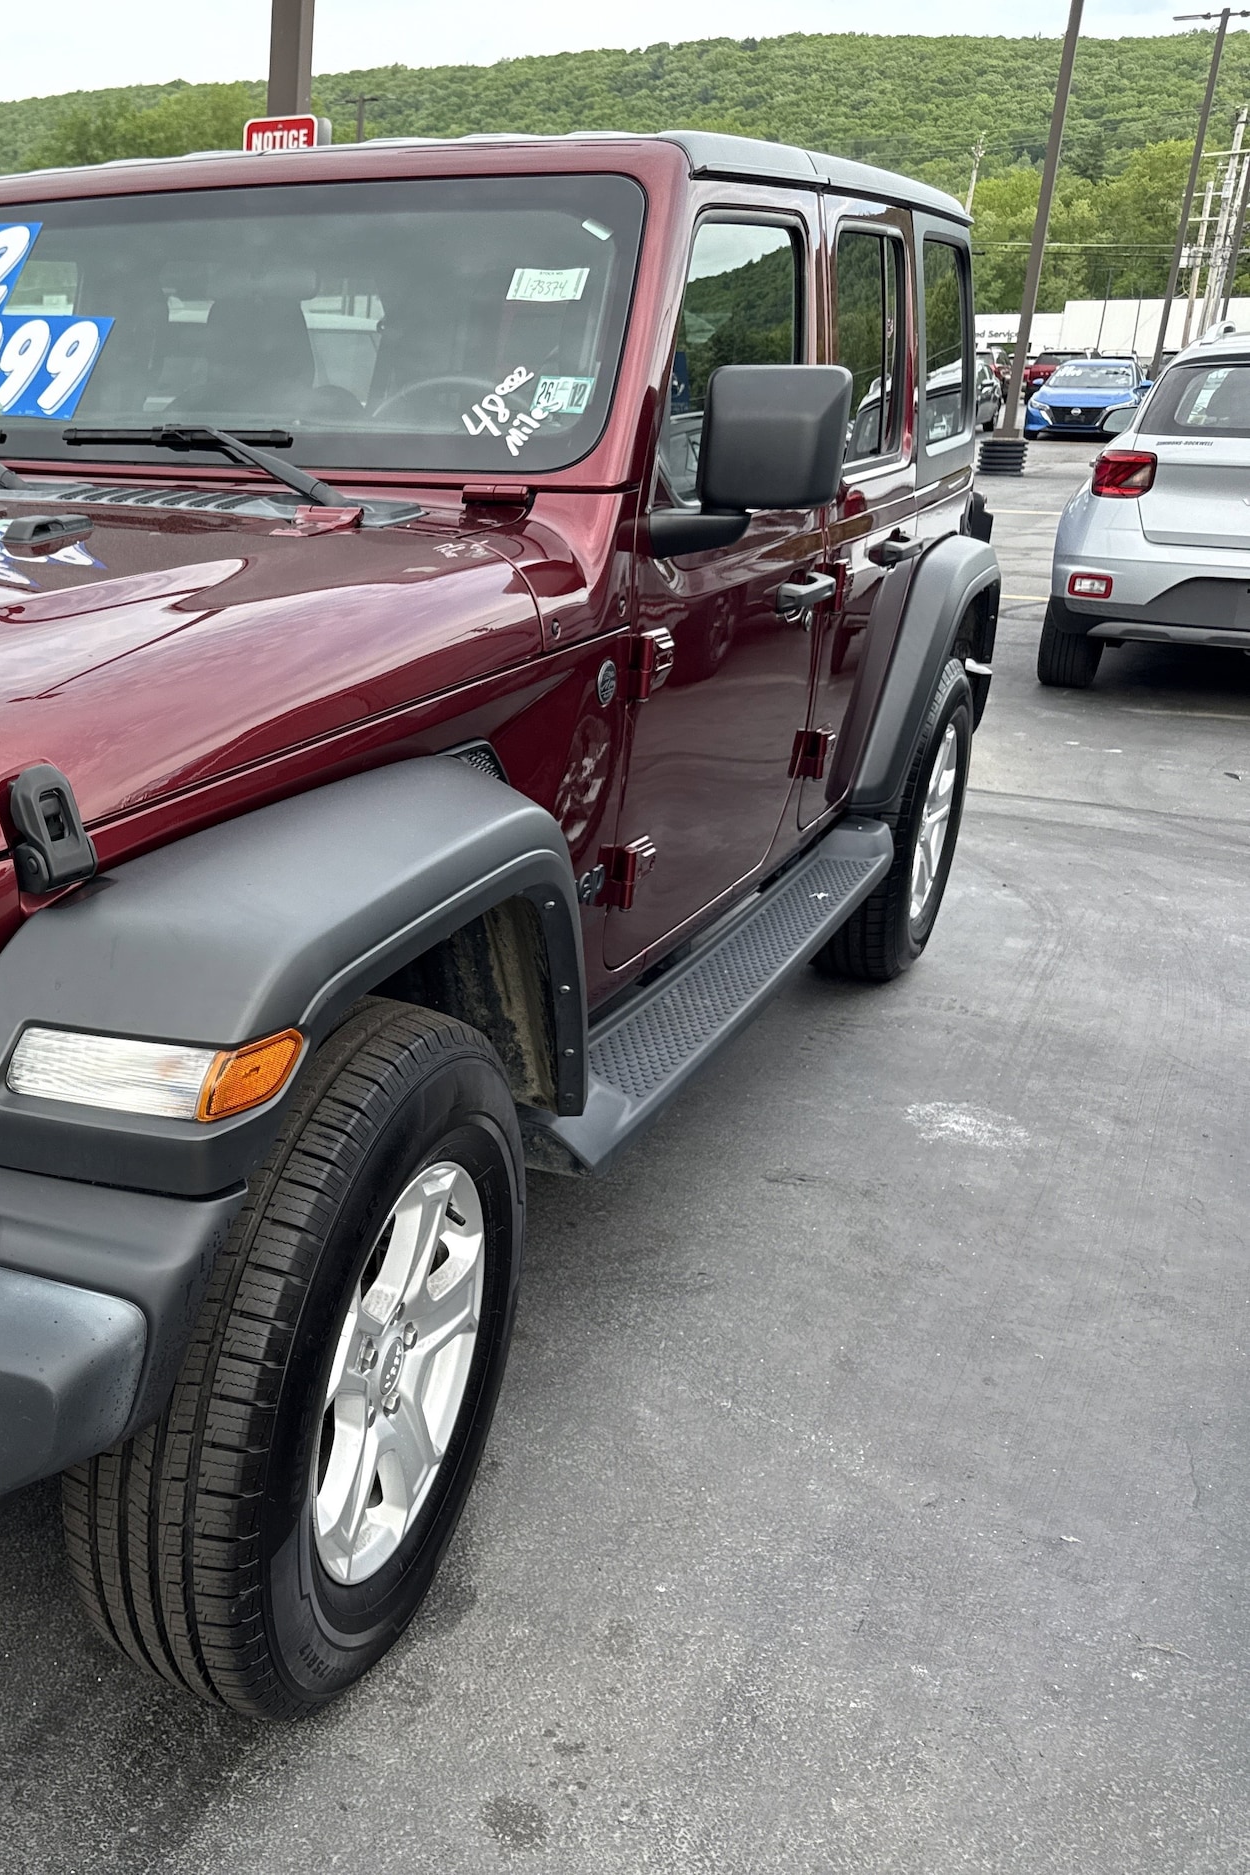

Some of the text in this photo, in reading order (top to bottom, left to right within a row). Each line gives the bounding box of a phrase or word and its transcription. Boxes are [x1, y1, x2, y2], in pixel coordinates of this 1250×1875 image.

[251, 128, 308, 152] NOTICE
[988, 330, 1019, 338] Servic
[569, 383, 588, 407] 12
